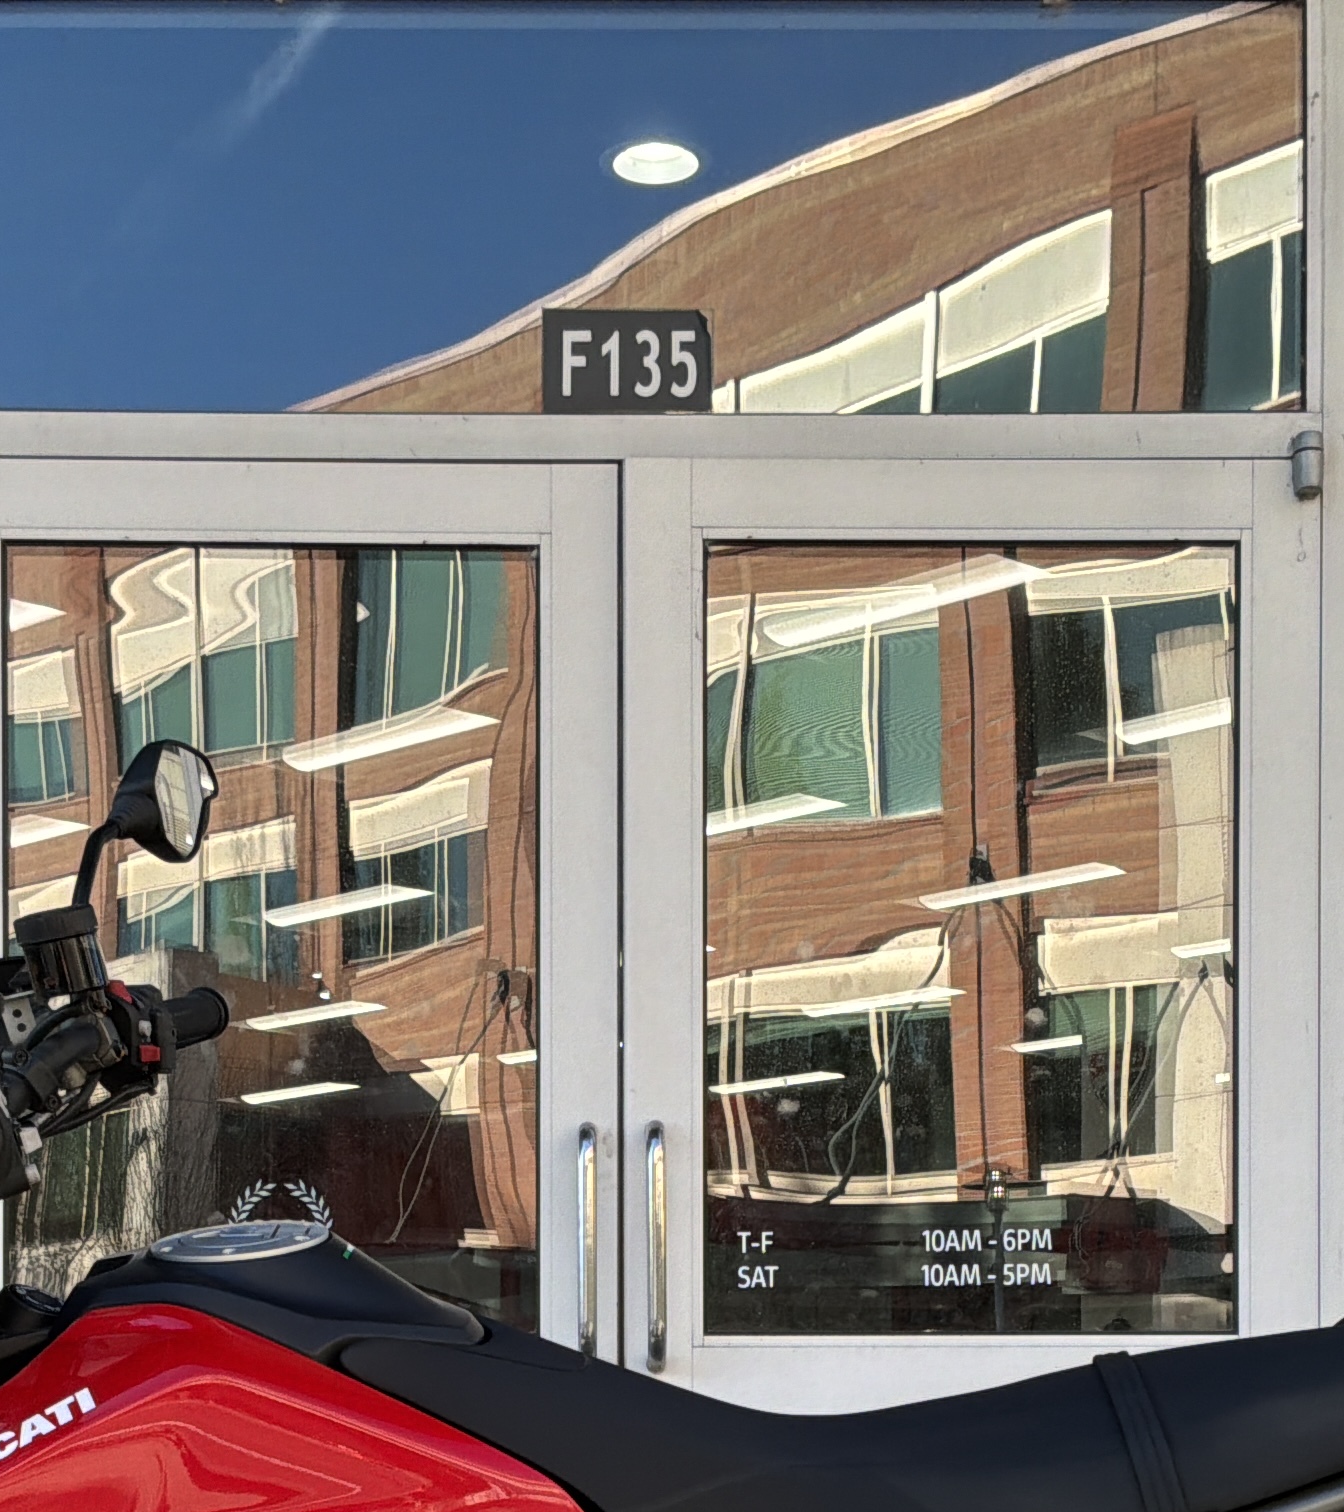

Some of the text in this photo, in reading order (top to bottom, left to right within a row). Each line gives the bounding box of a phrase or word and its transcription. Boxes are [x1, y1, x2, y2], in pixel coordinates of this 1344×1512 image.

[561, 329, 698, 398] F135
[737, 1231, 774, 1254] T-F
[922, 1229, 982, 1253] 10AM
[1003, 1229, 1053, 1252] 6PM
[737, 1266, 779, 1289] SAT
[921, 1265, 981, 1287] 10AM
[1003, 1264, 1052, 1287] 5PM
